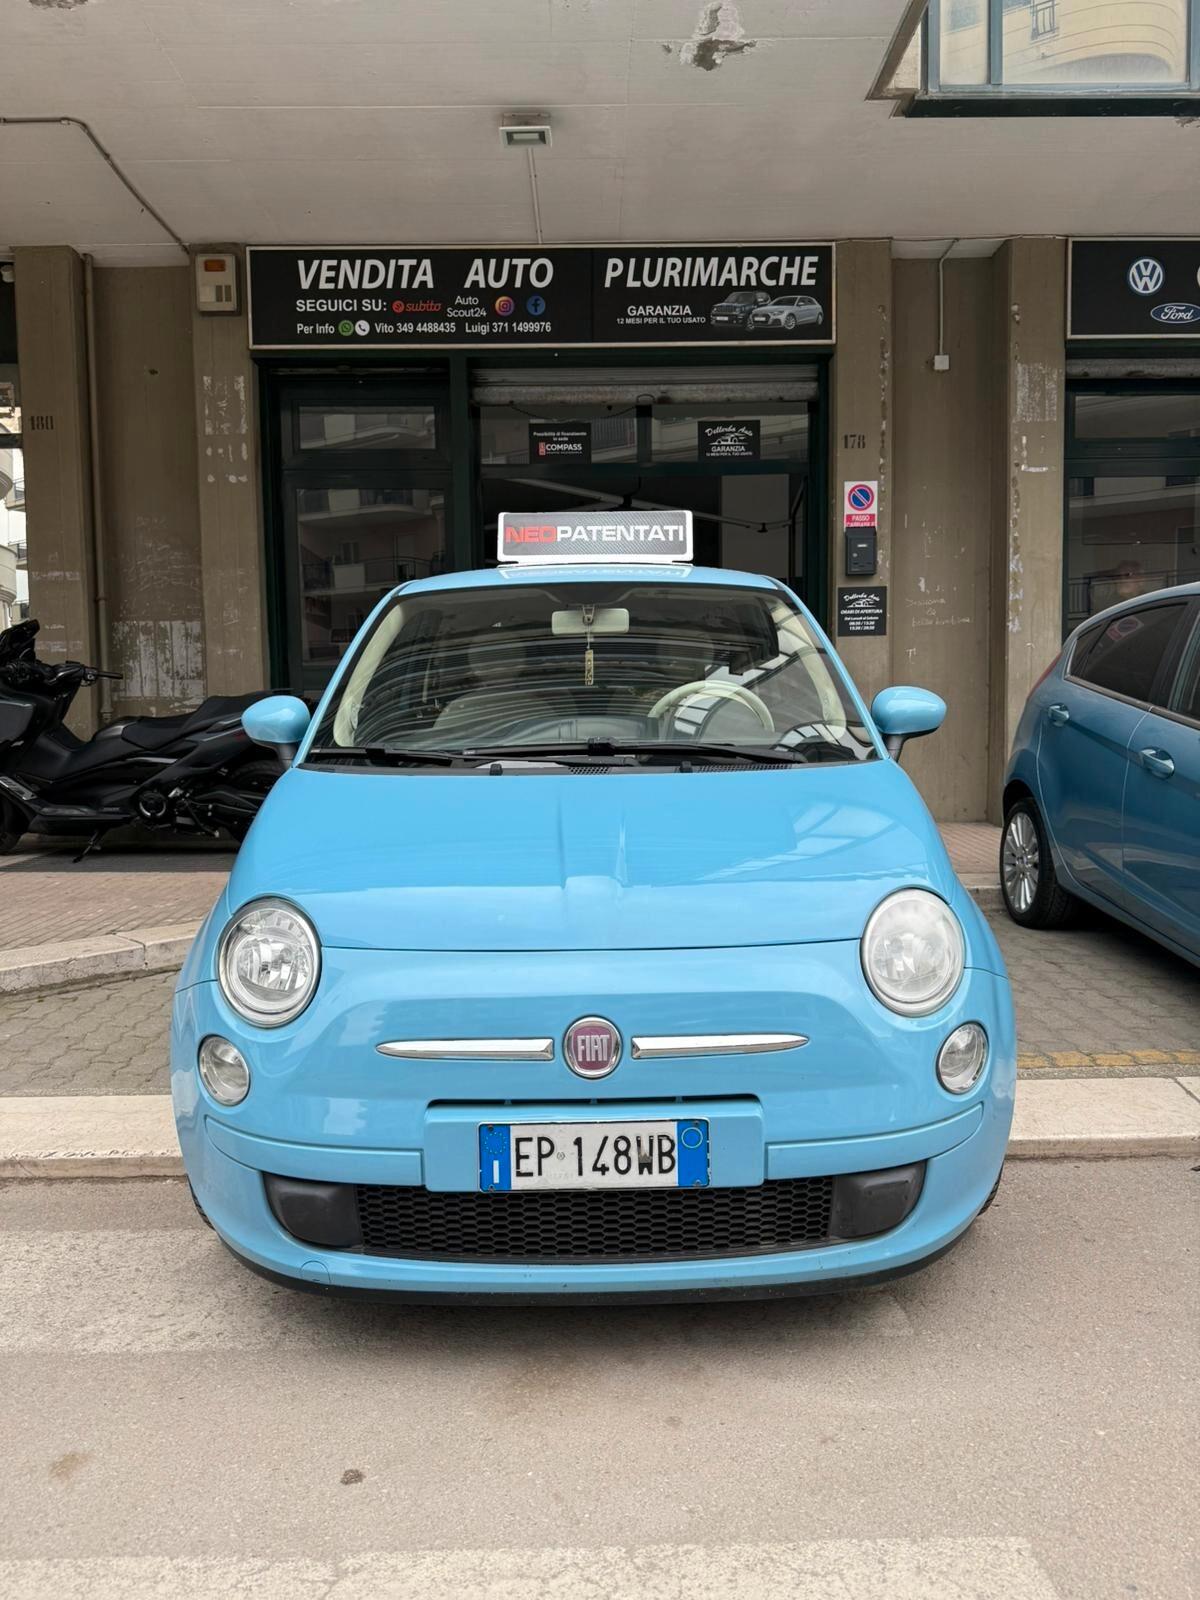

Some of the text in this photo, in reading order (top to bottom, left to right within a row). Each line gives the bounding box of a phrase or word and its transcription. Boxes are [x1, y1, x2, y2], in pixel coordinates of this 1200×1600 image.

[297, 257, 554, 290] VENDITA AUTO
[604, 255, 819, 288] PLURIMARCHE
[295, 299, 442, 313] SEGUICI SU: subito
[454, 295, 479, 306] Auto
[446, 307, 487, 318] Scout24
[627, 305, 692, 317] GARANZIA
[1160, 306, 1195, 320] Ford
[643, 317, 658, 325] PER
[296, 321, 552, 336] Per Info Vito 349 4488435 Luigi 371 1499976
[545, 443, 583, 451] COMPASS
[844, 434, 866, 449] 178
[851, 514, 870, 522] PASSO
[505, 525, 684, 543] NEOPATENTATI
[577, 1034, 610, 1062] FIAT
[515, 1134, 676, 1178] EP 148WB
